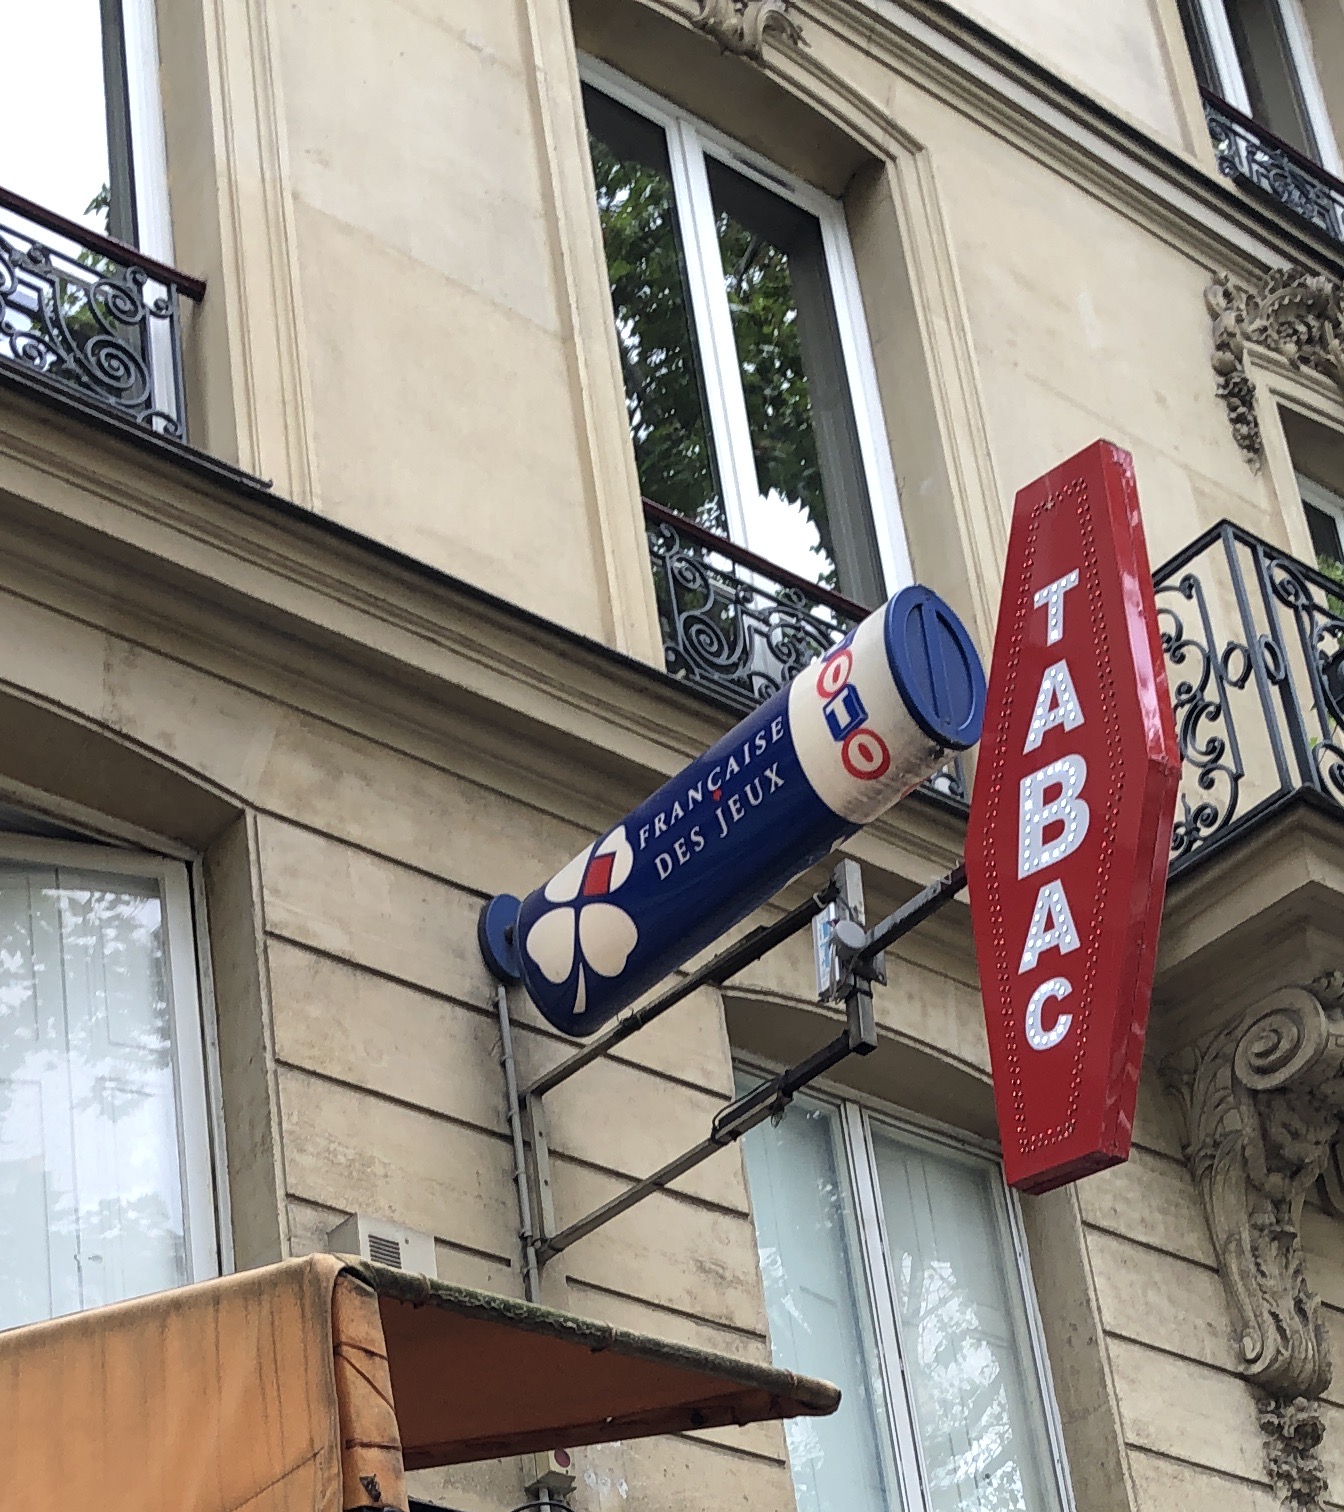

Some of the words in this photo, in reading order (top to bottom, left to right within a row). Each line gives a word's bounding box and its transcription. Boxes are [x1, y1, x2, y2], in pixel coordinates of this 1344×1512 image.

[637, 714, 787, 850] FRANÇAISE
[653, 824, 706, 882] DES
[716, 761, 788, 838] JEUX
[1017, 569, 1089, 1051] TABAC
